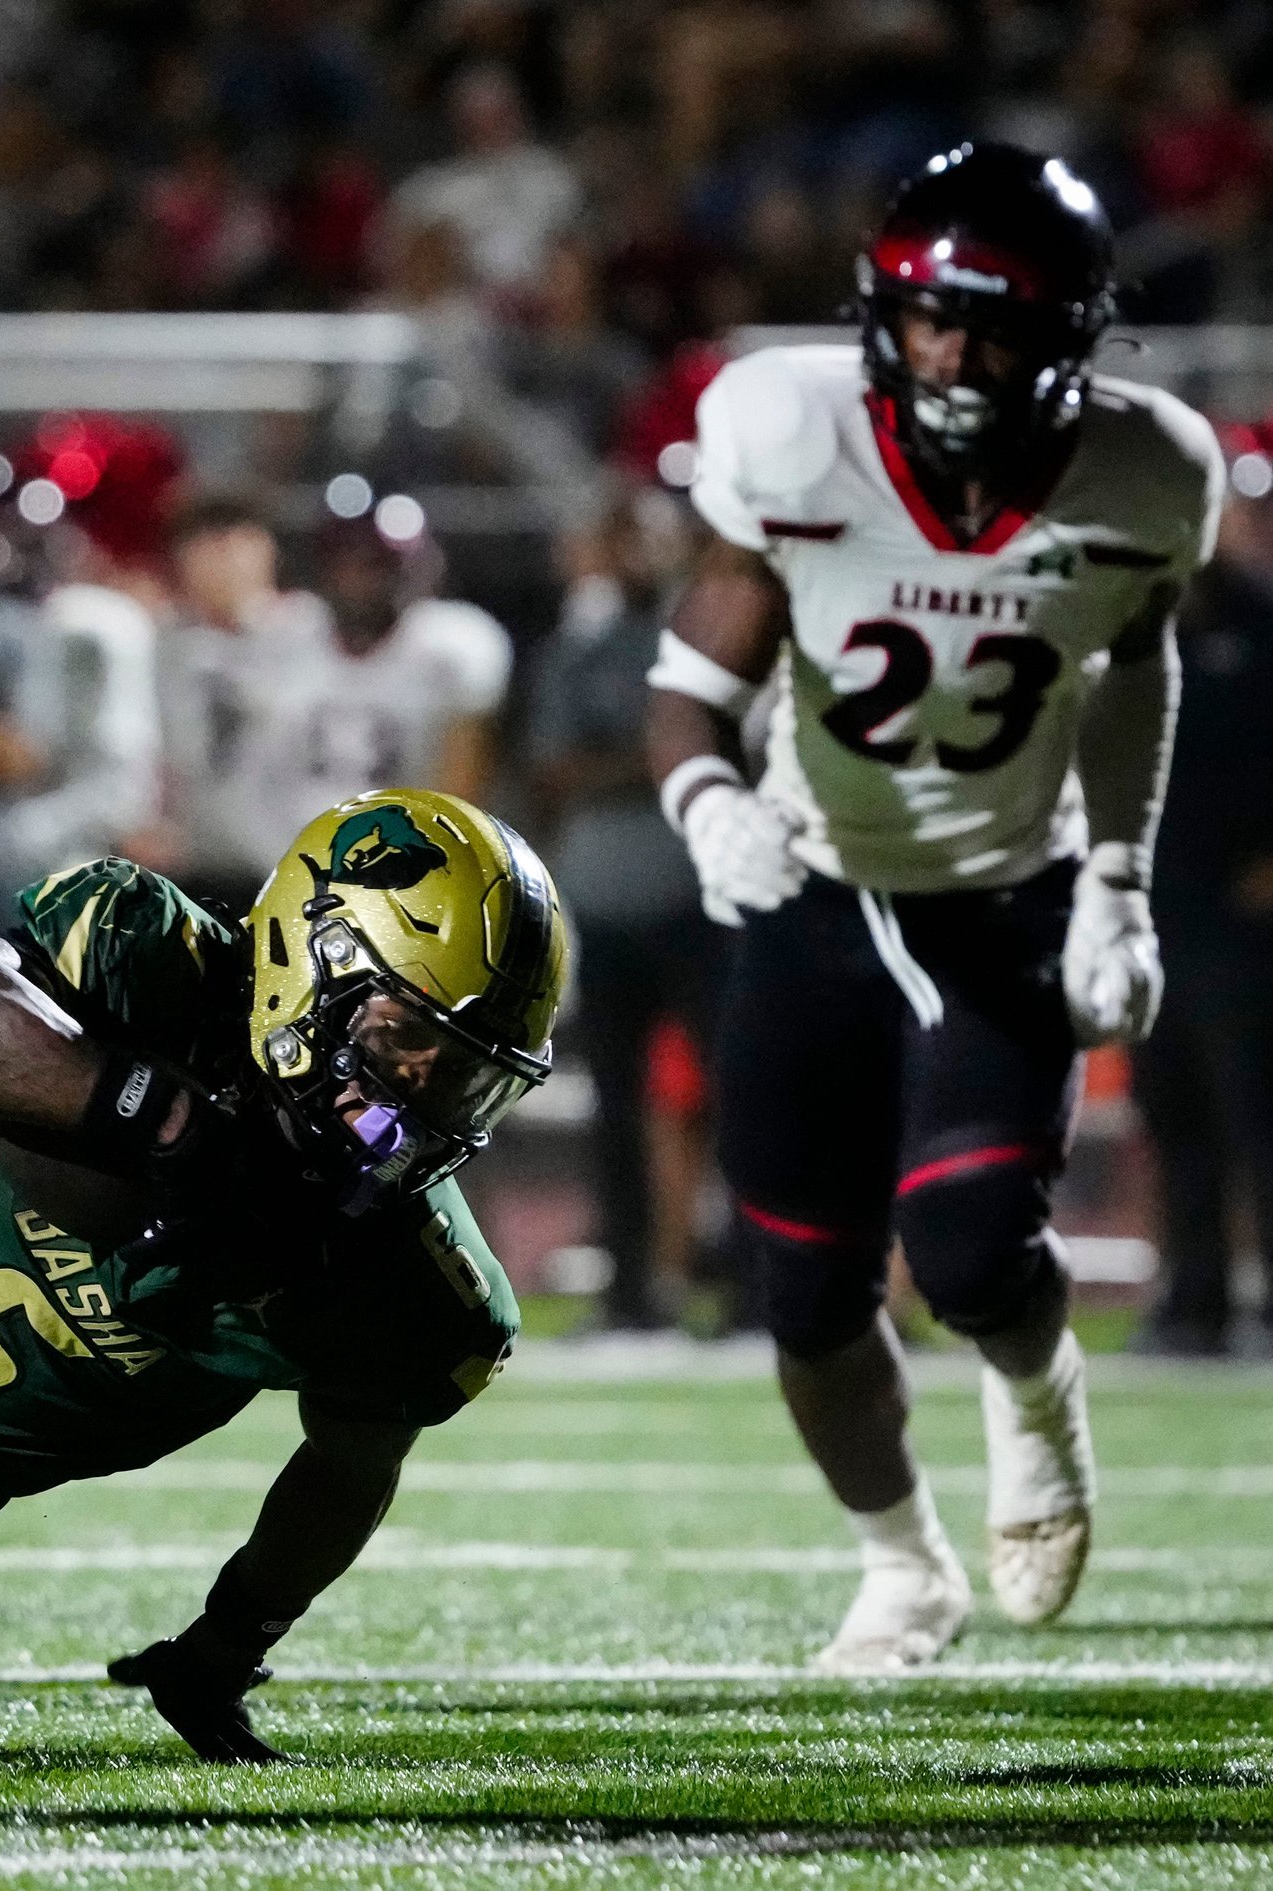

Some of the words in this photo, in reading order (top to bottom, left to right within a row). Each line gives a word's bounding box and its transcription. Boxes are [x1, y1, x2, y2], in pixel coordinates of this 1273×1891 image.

[892, 579, 1027, 624] LIBERTY
[821, 617, 1061, 772] 23
[420, 1211, 490, 1310] 6
